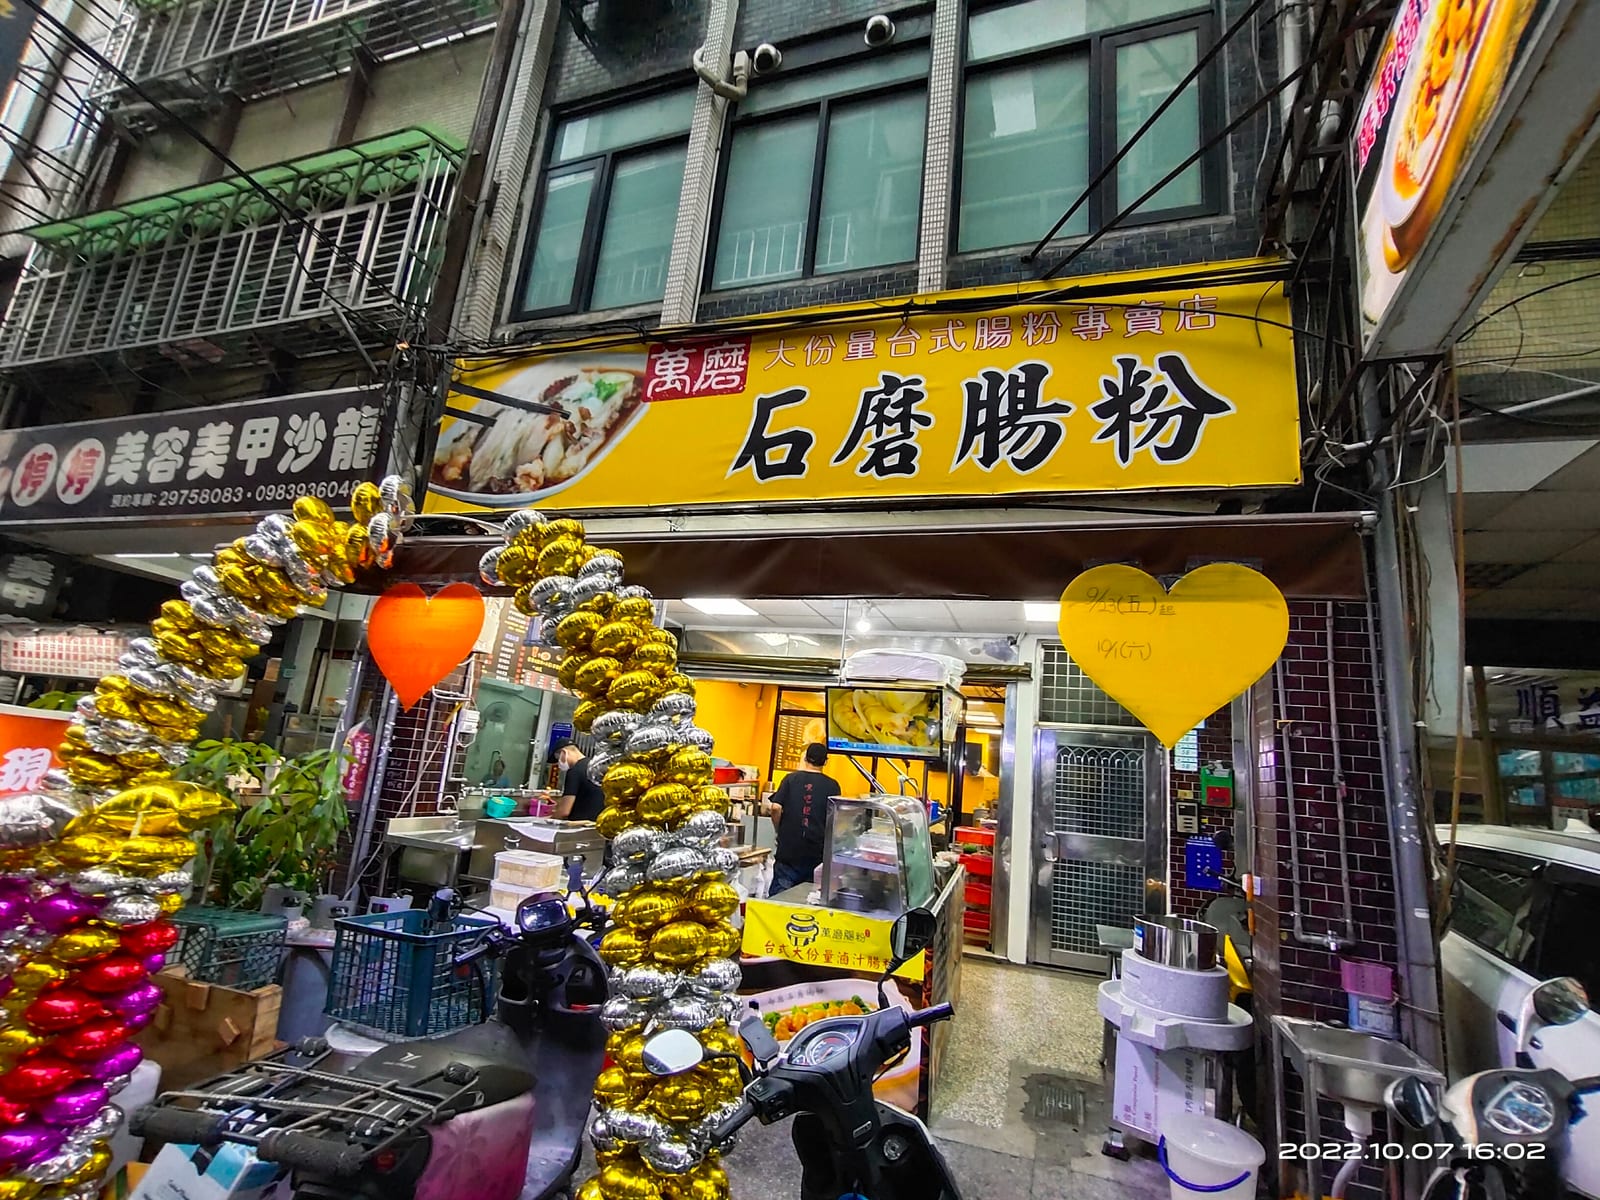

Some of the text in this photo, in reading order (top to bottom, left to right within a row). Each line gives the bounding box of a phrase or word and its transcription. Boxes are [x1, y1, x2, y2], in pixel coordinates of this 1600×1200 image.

[646, 341, 748, 399] 萬磨
[763, 293, 1218, 372] 大份量台式腸粉專賣店
[104, 404, 381, 487] 美容美甲沙龍
[726, 351, 1235, 482] 石磨腸粉
[158, 485, 244, 507] 29758083
